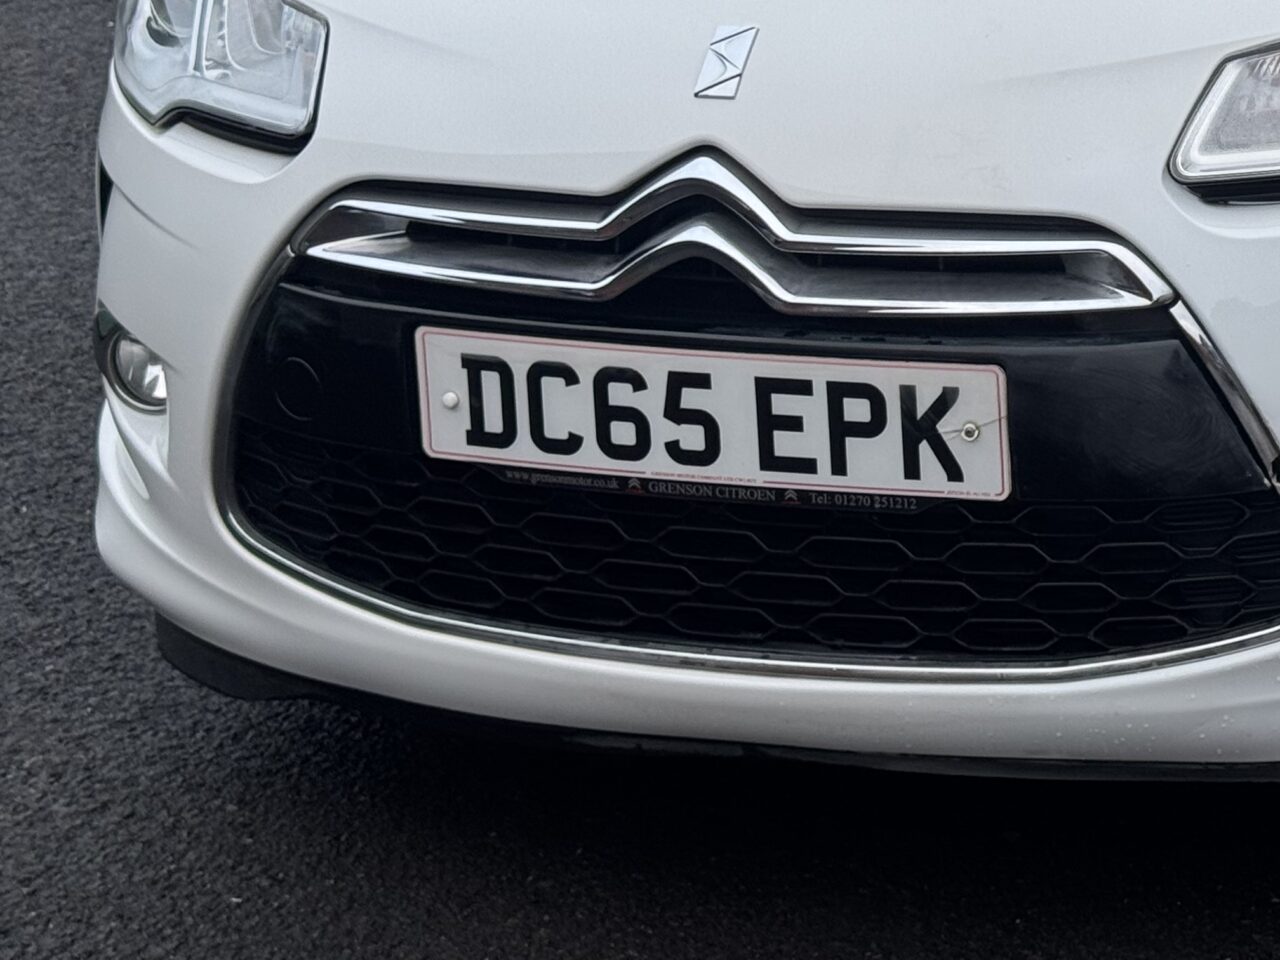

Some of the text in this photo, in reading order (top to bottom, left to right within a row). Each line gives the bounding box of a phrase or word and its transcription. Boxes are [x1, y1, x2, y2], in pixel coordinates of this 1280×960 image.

[461, 353, 964, 483] DC65 EPK
[648, 481, 712, 497] GRENSON
[715, 486, 776, 501] CITROEN
[809, 491, 830, 504] Tel:
[834, 494, 870, 507] 01270
